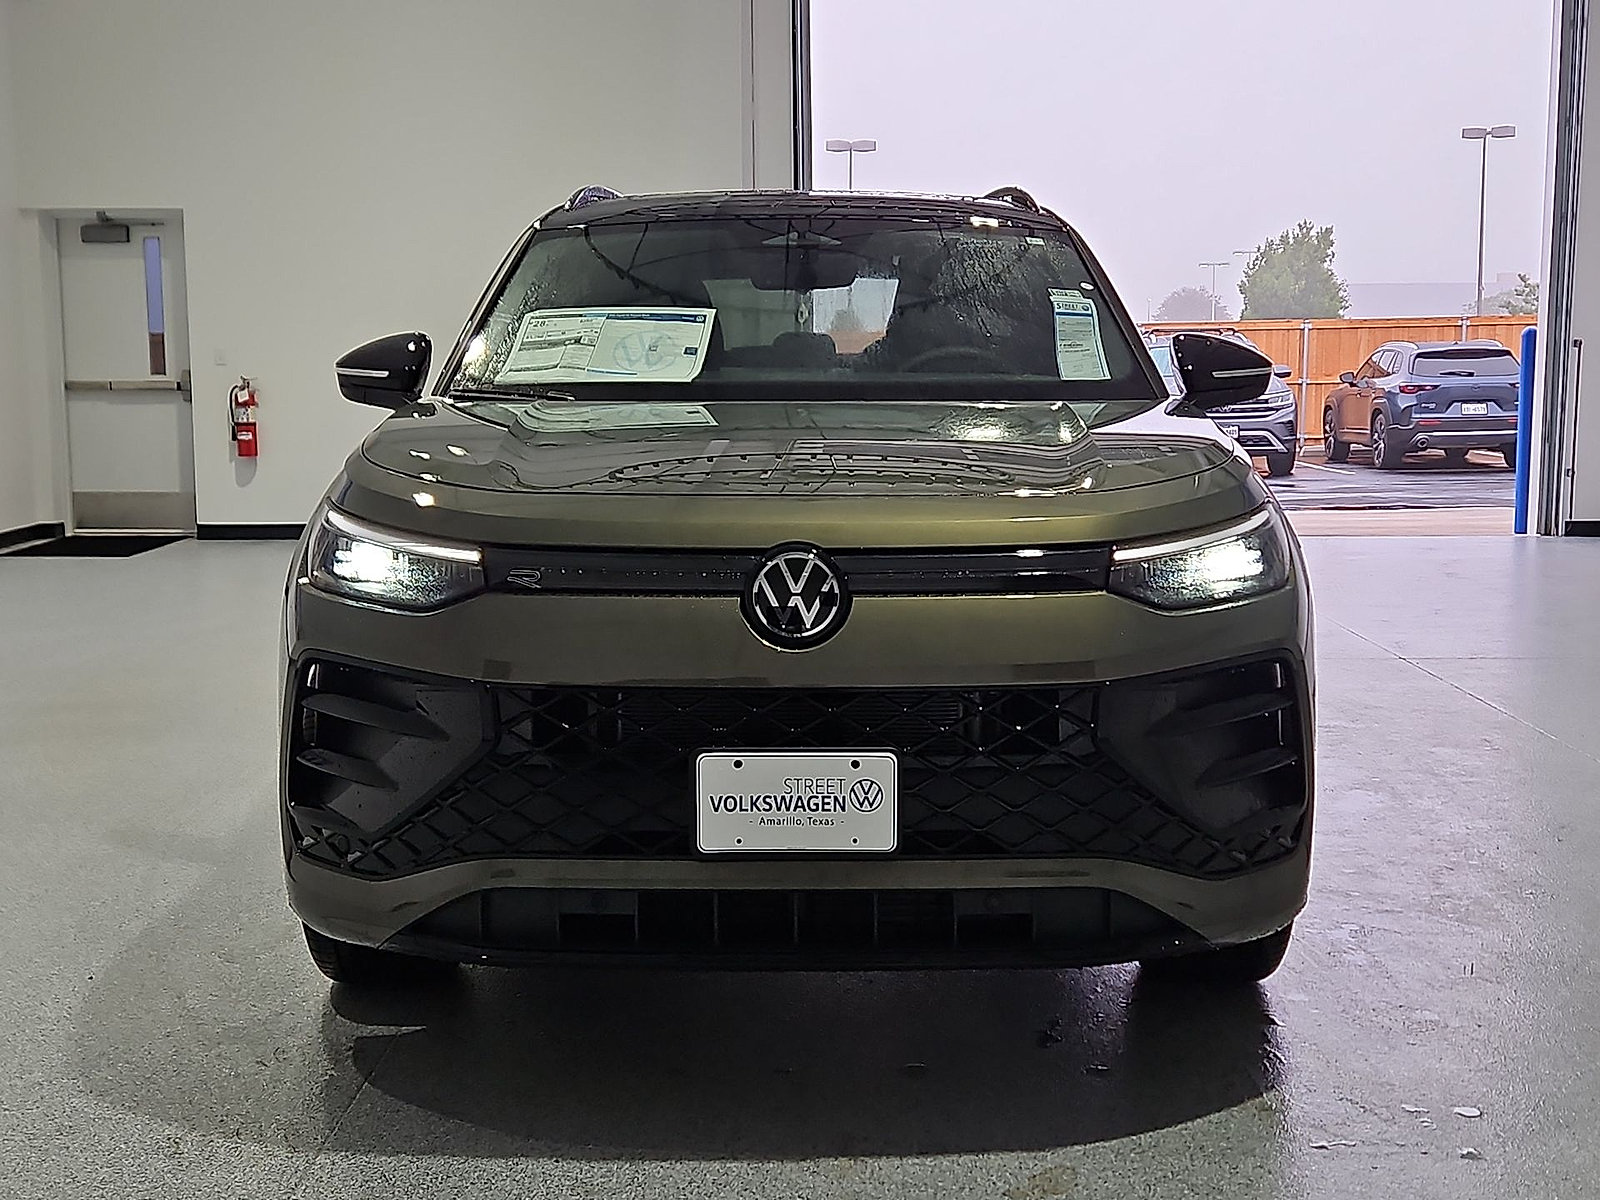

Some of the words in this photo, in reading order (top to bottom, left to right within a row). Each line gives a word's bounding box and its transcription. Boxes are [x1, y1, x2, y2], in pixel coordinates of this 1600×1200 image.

[783, 777, 846, 795] STREET
[708, 794, 847, 813] VOLKSWAGEN
[758, 816, 805, 827] Amarillo,
[806, 816, 835, 826] Texas
